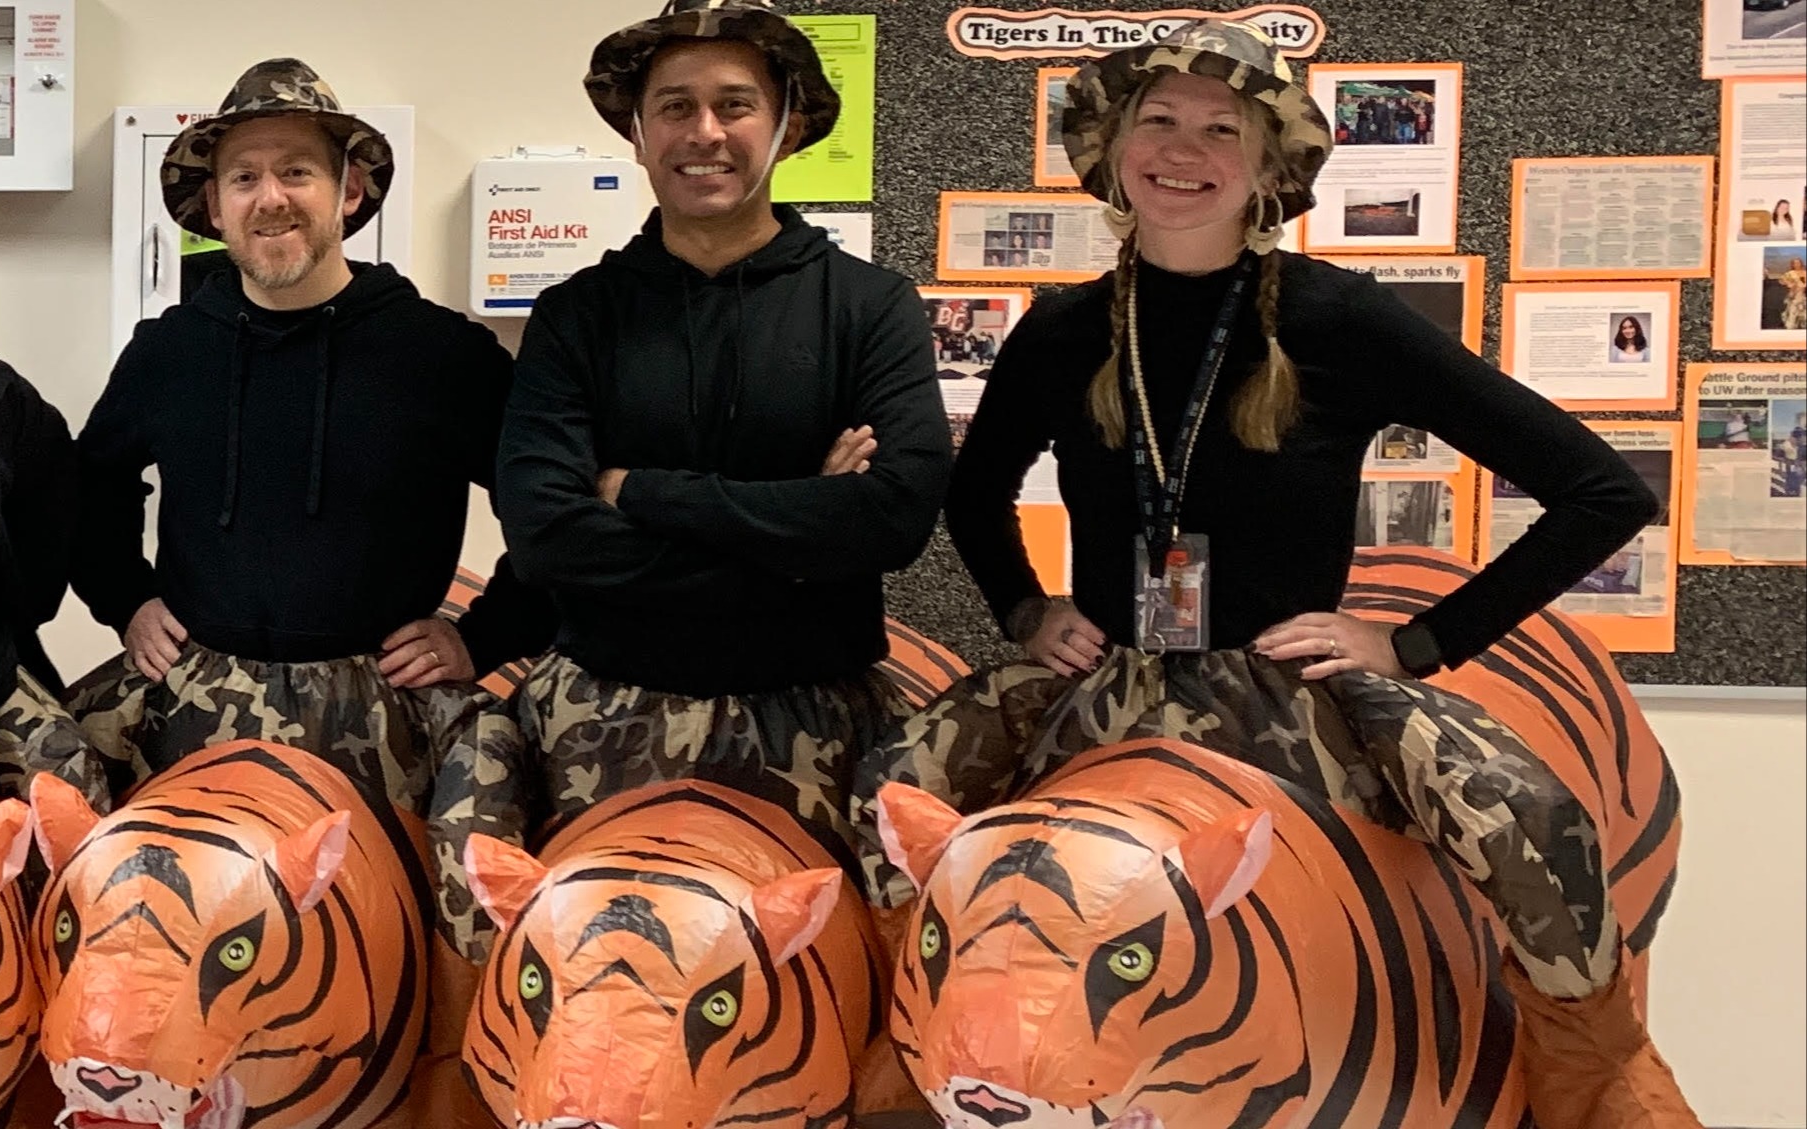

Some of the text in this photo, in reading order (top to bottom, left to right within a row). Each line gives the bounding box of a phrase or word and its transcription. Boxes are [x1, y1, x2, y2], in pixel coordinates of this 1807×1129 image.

[968, 22, 1047, 45] Tigers
[1057, 24, 1083, 43] In
[1094, 25, 1142, 44] The
[488, 209, 532, 224] ANSI
[488, 225, 588, 240] First Aid Kit
[1404, 266, 1442, 279] sparks
[1446, 266, 1461, 279] fly
[1705, 373, 1733, 382] attle
[1737, 372, 1779, 382] Ground
[1698, 385, 1710, 395] to
[1714, 386, 1733, 395] UW
[1737, 385, 1763, 395] after
